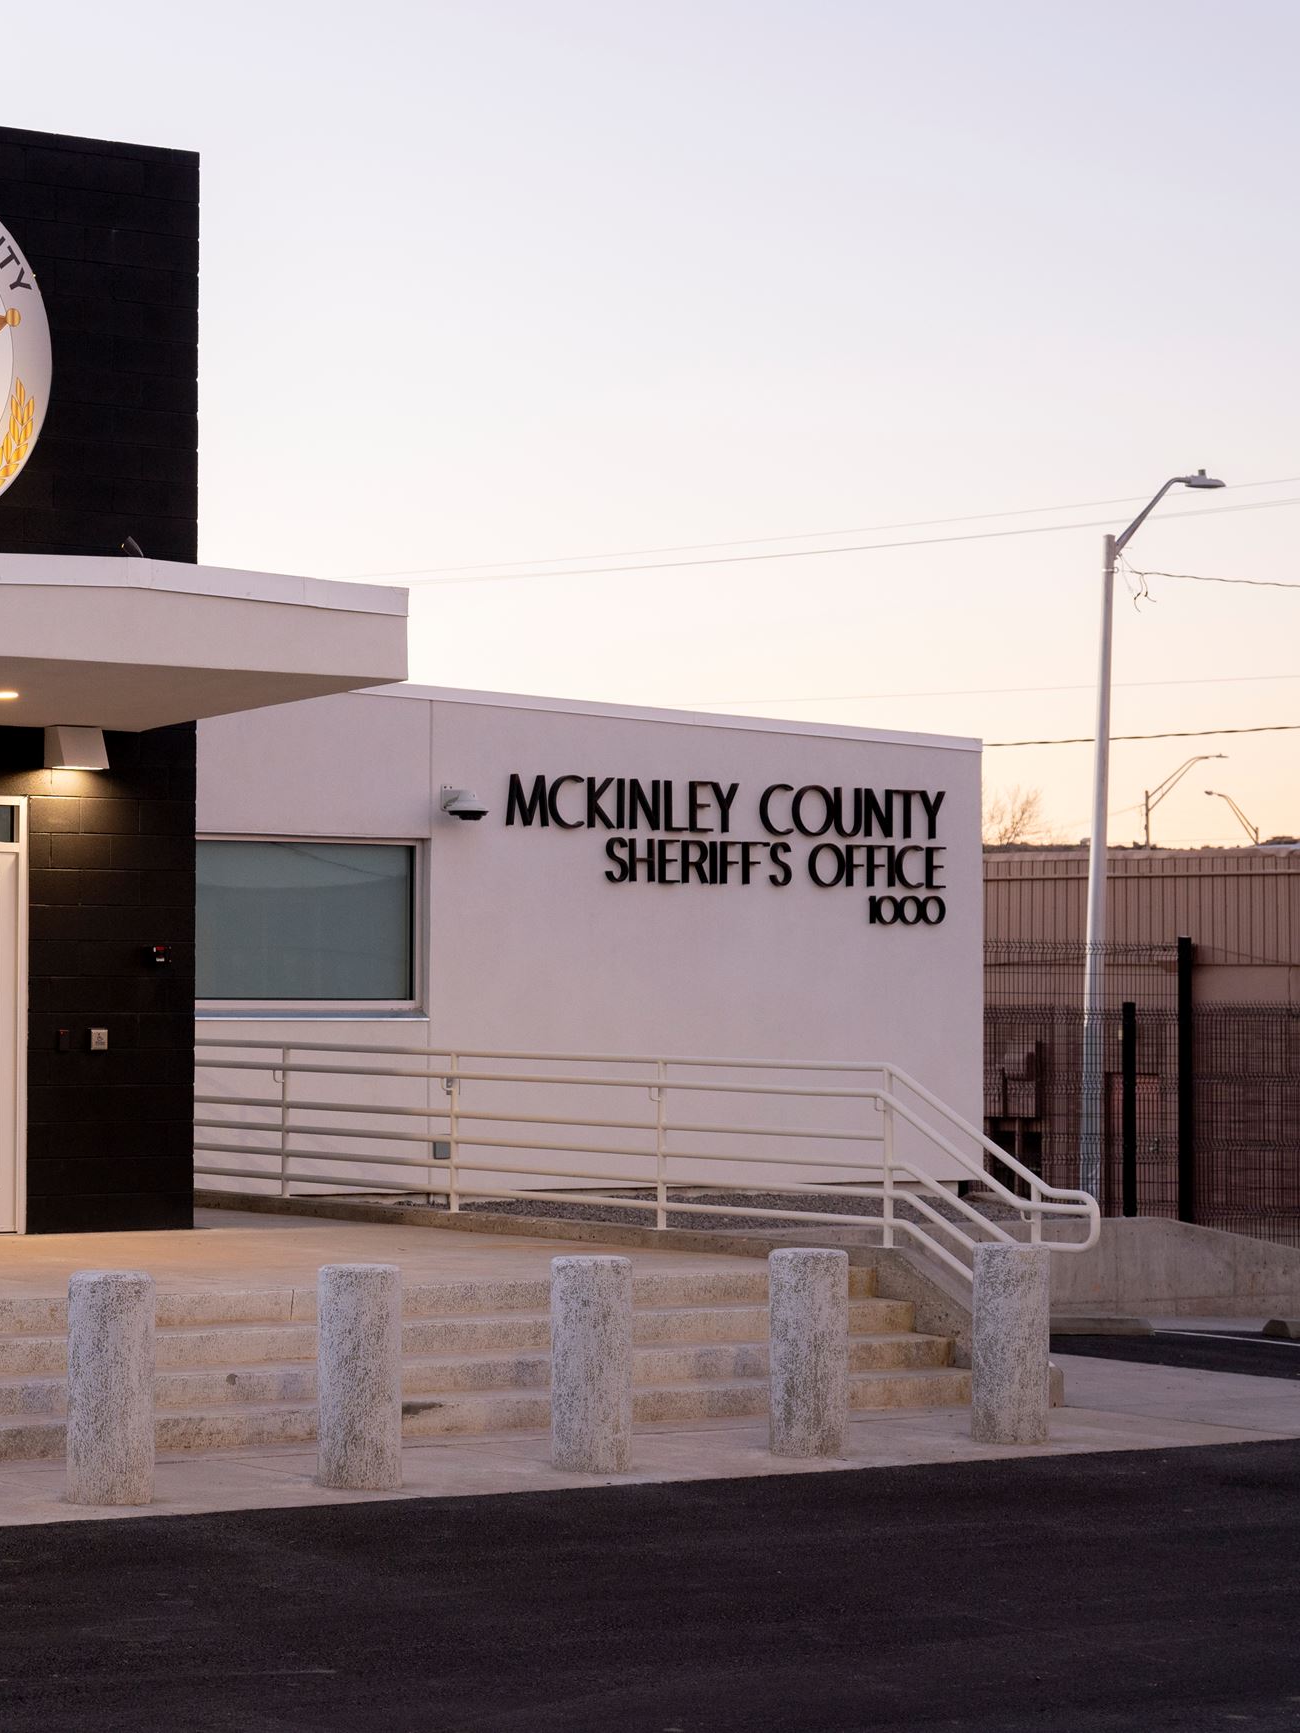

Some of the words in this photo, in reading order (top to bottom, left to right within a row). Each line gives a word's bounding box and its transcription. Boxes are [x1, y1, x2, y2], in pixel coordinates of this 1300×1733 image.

[505, 773, 739, 834] MCKINLEY
[759, 783, 946, 840] COUNTY
[808, 842, 947, 889] OFFICE
[869, 895, 947, 926] 1000
